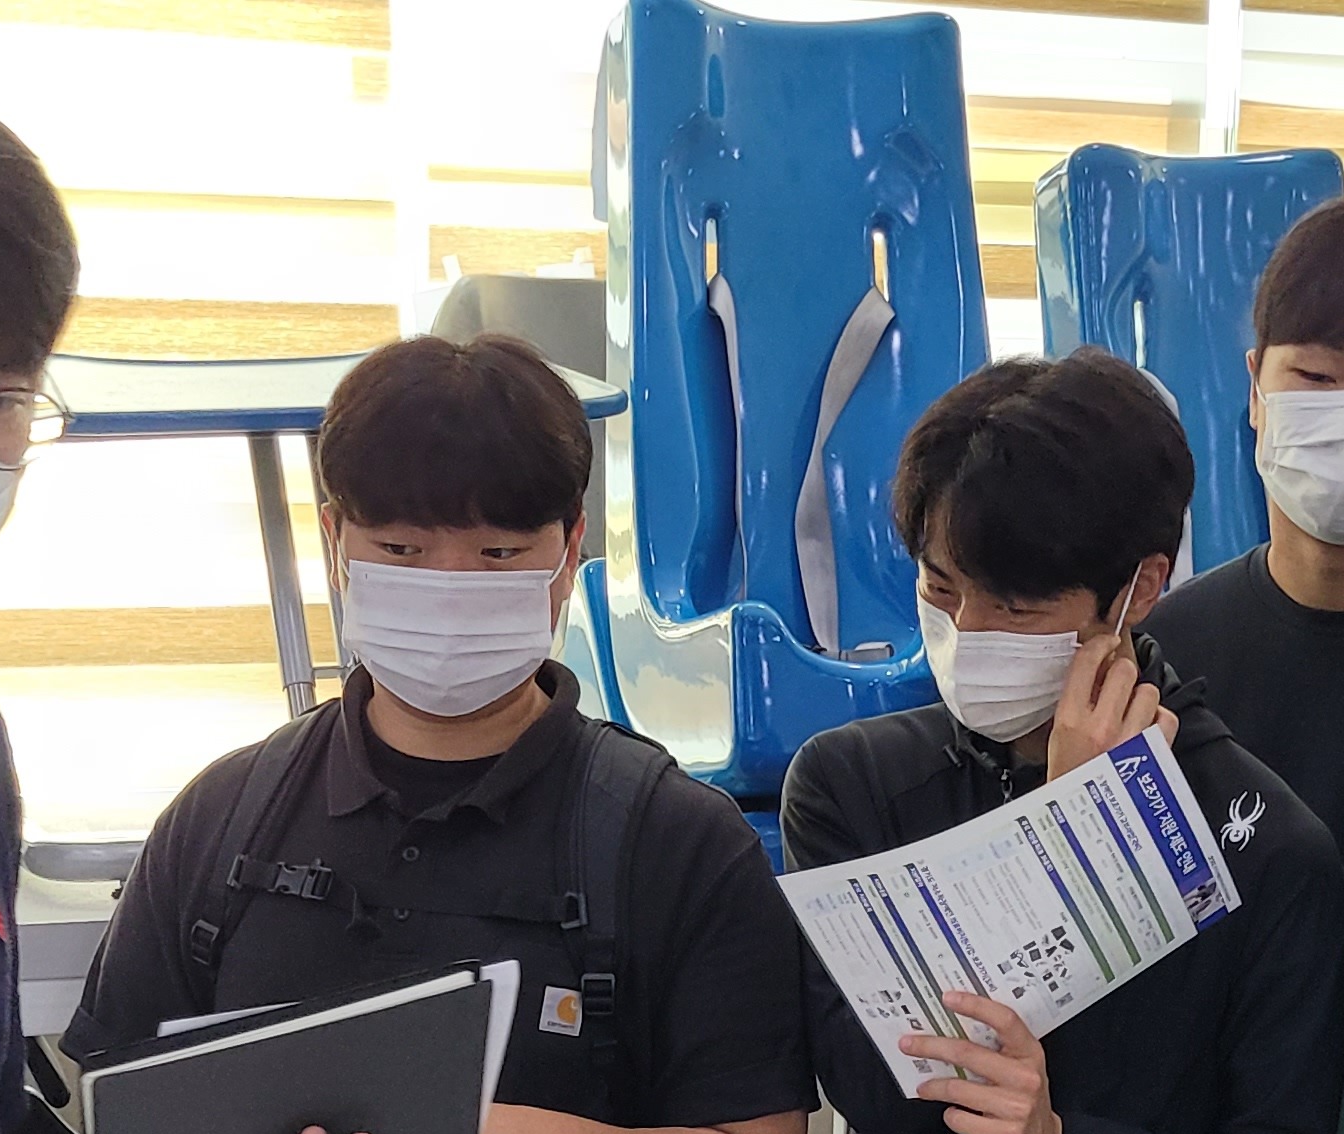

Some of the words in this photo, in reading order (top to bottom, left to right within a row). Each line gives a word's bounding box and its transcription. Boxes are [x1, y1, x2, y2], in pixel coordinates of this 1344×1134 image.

[1136, 772, 1169, 817] 보조기기
[1157, 812, 1179, 838] 지원
[1175, 851, 1198, 875] 안내
